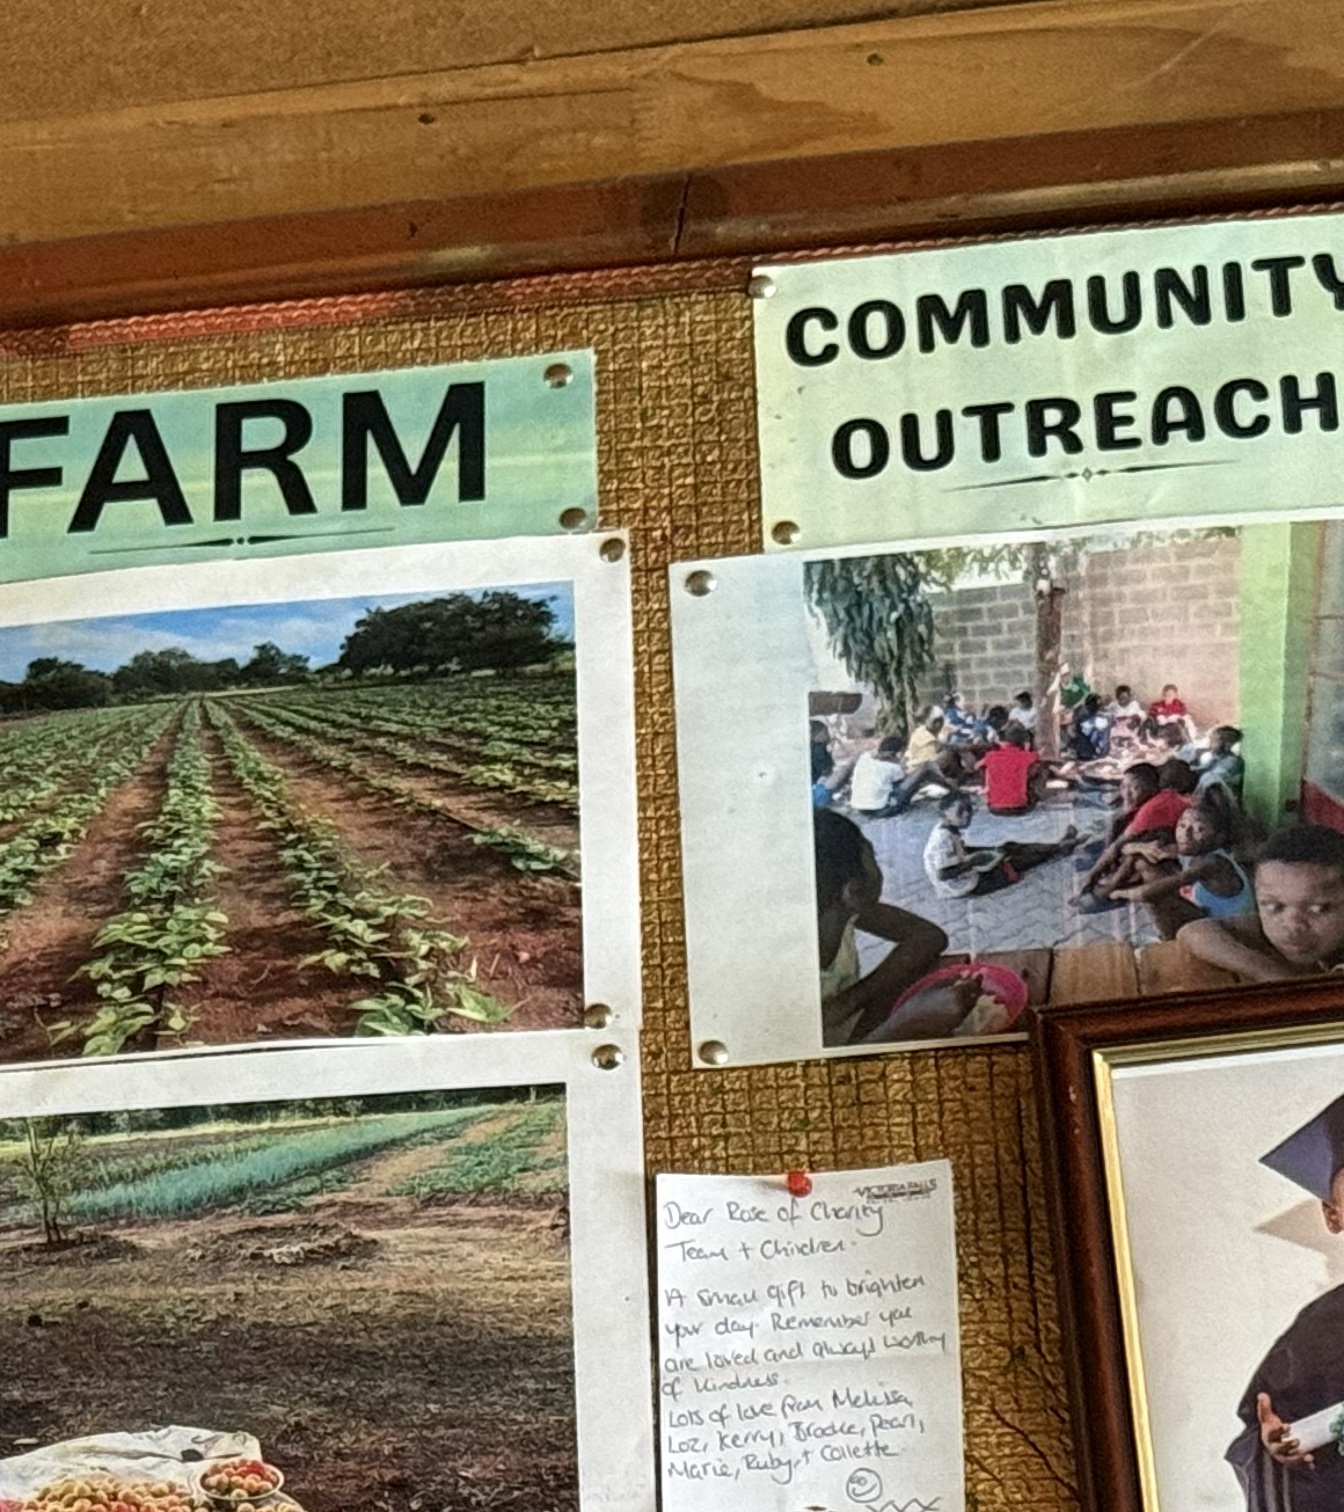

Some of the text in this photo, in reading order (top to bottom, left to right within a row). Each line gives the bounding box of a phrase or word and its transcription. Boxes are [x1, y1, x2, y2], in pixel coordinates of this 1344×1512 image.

[785, 252, 1344, 368] COMMUNITY
[831, 371, 1340, 480] OUTREACH
[664, 1200, 883, 1236] Dear Rose of Charity
[665, 1240, 727, 1262] Team
[665, 1288, 685, 1307] A
[767, 1281, 805, 1308] gift
[822, 1280, 838, 1299] to
[847, 1272, 926, 1298] brighten
[665, 1323, 702, 1348] your
[771, 1312, 869, 1332] Remember
[665, 1356, 700, 1373] are
[707, 1350, 759, 1369] loved
[764, 1343, 803, 1363] and
[813, 1338, 875, 1360] always
[661, 1377, 683, 1399] of
[709, 1408, 729, 1427] of
[738, 1404, 776, 1421] love
[781, 1395, 823, 1418] from
